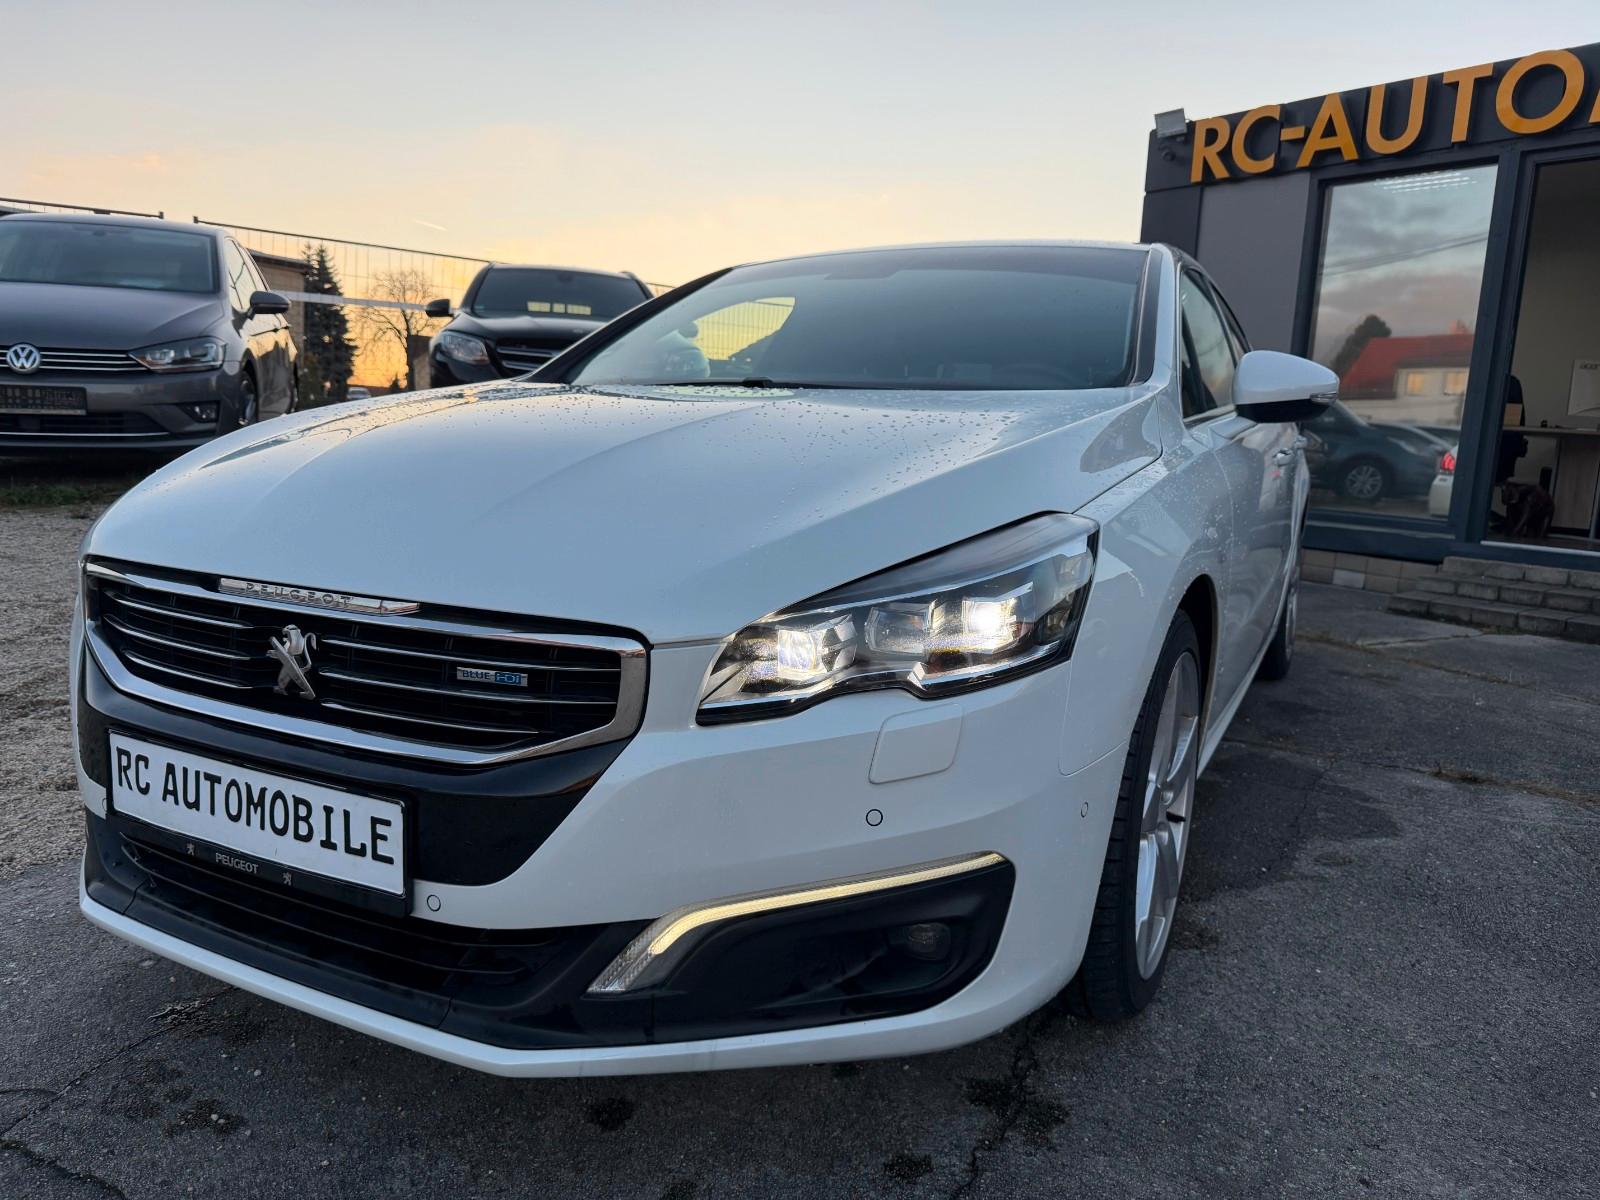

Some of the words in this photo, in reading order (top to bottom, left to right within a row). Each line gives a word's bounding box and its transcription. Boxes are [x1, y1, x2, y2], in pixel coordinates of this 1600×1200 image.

[1191, 49, 1600, 184] RC-AUTO
[8, 345, 39, 371] VW
[244, 582, 354, 605] PEUGEOT
[462, 669, 491, 680] BLUE
[116, 746, 151, 795] RC
[162, 762, 394, 865] AUTOMOBILE
[215, 852, 259, 874] PEUGEOT
